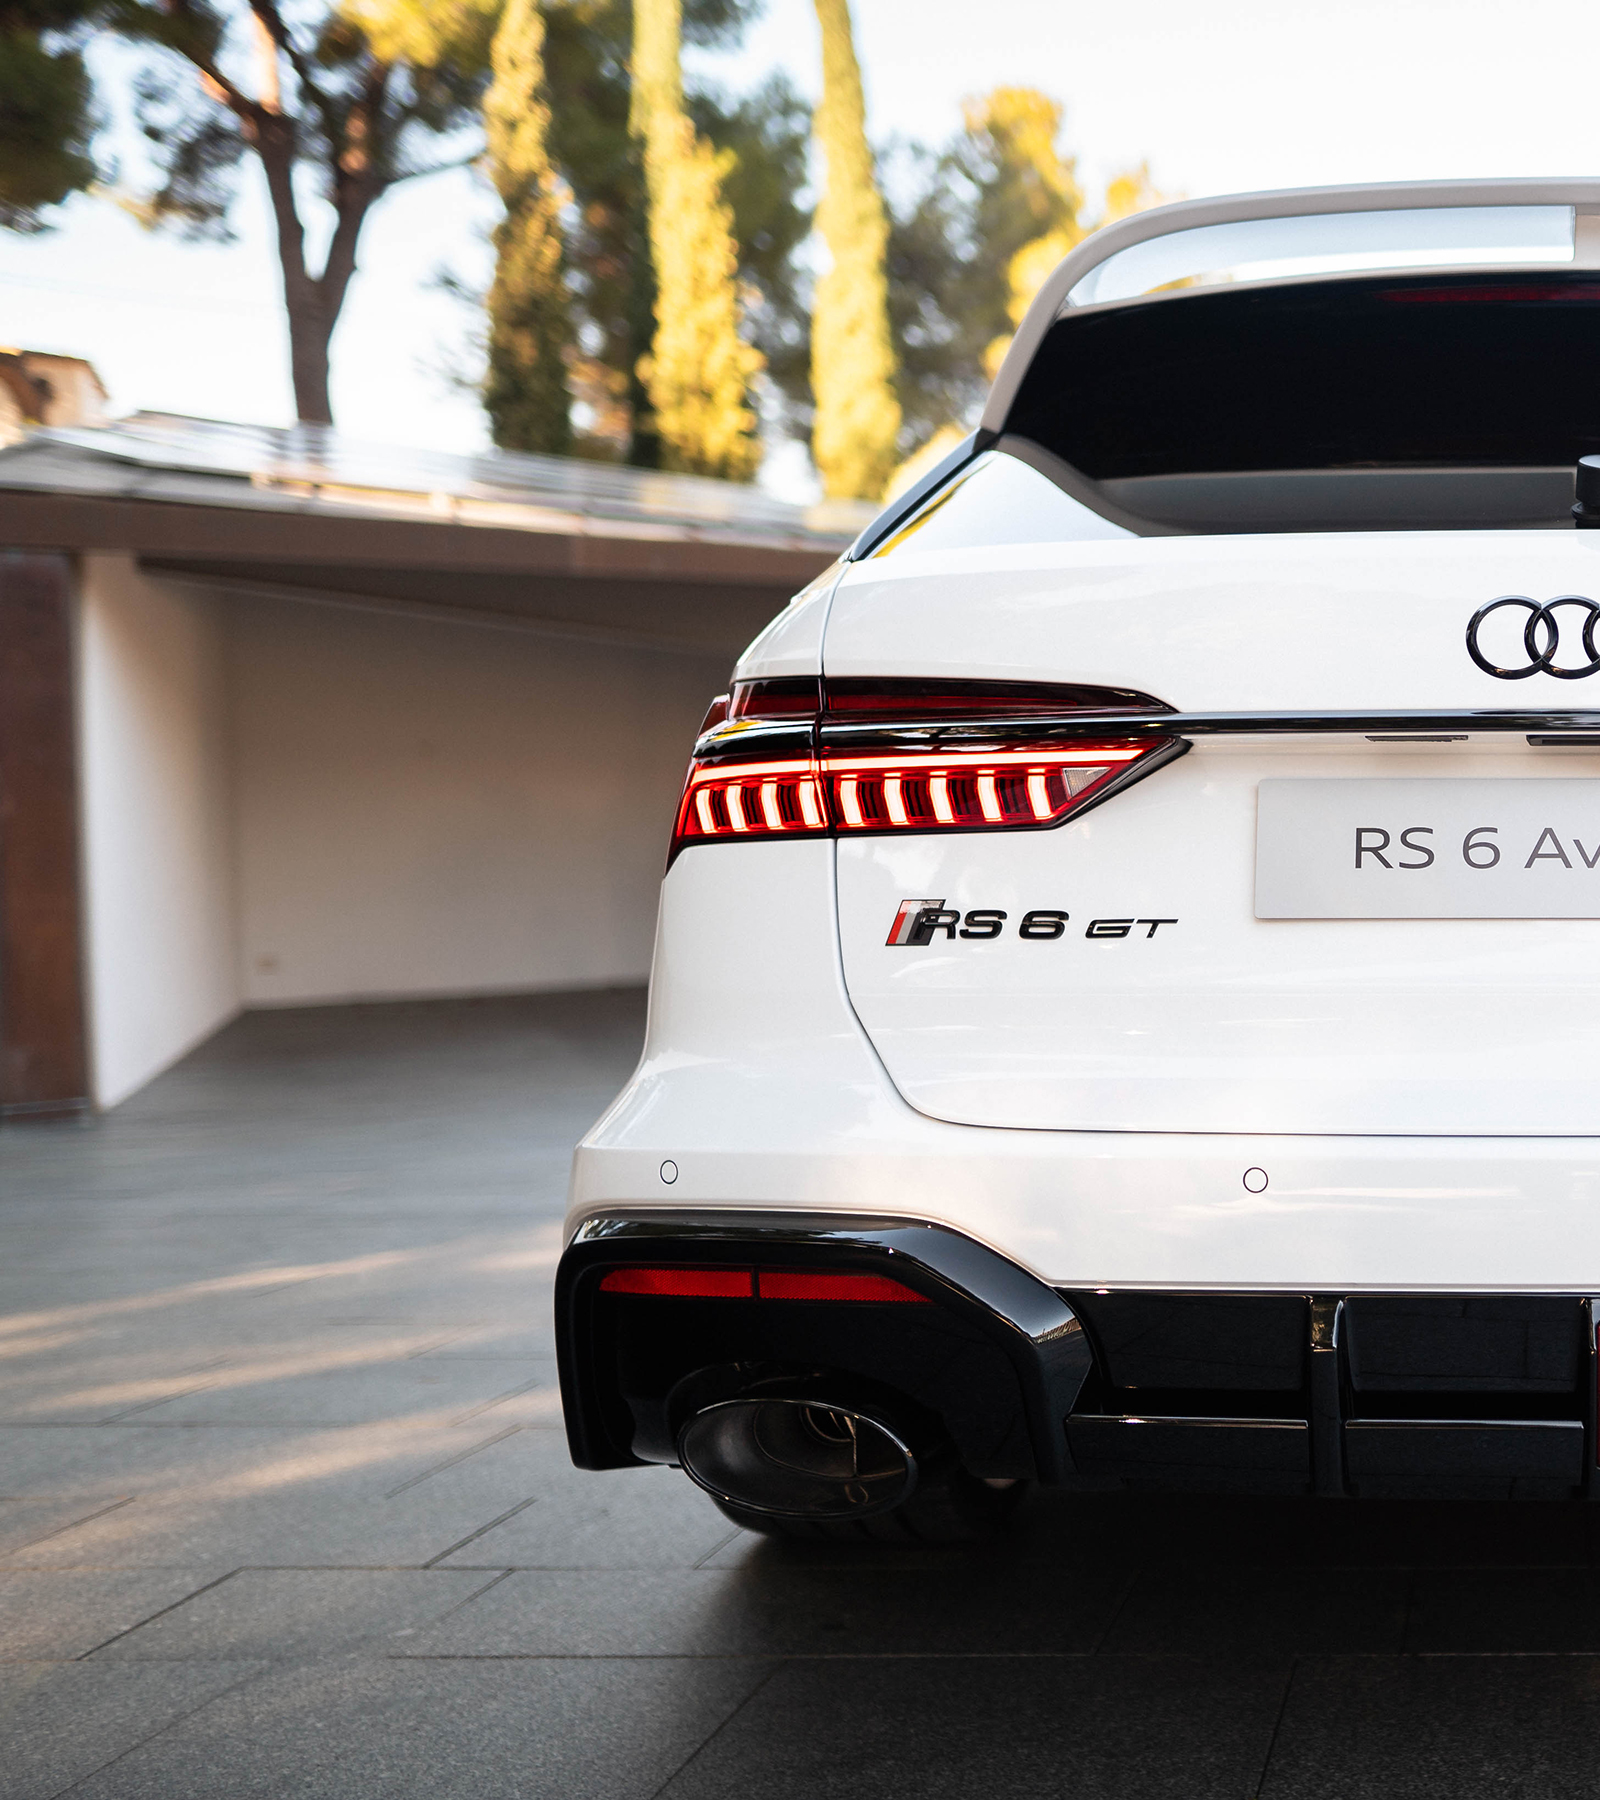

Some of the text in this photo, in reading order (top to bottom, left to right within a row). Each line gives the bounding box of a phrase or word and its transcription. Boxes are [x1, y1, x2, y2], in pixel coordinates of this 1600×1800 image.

[1354, 826, 1436, 871] RS
[1461, 826, 1501, 871] 6
[913, 909, 1179, 941] RS 6 GT
